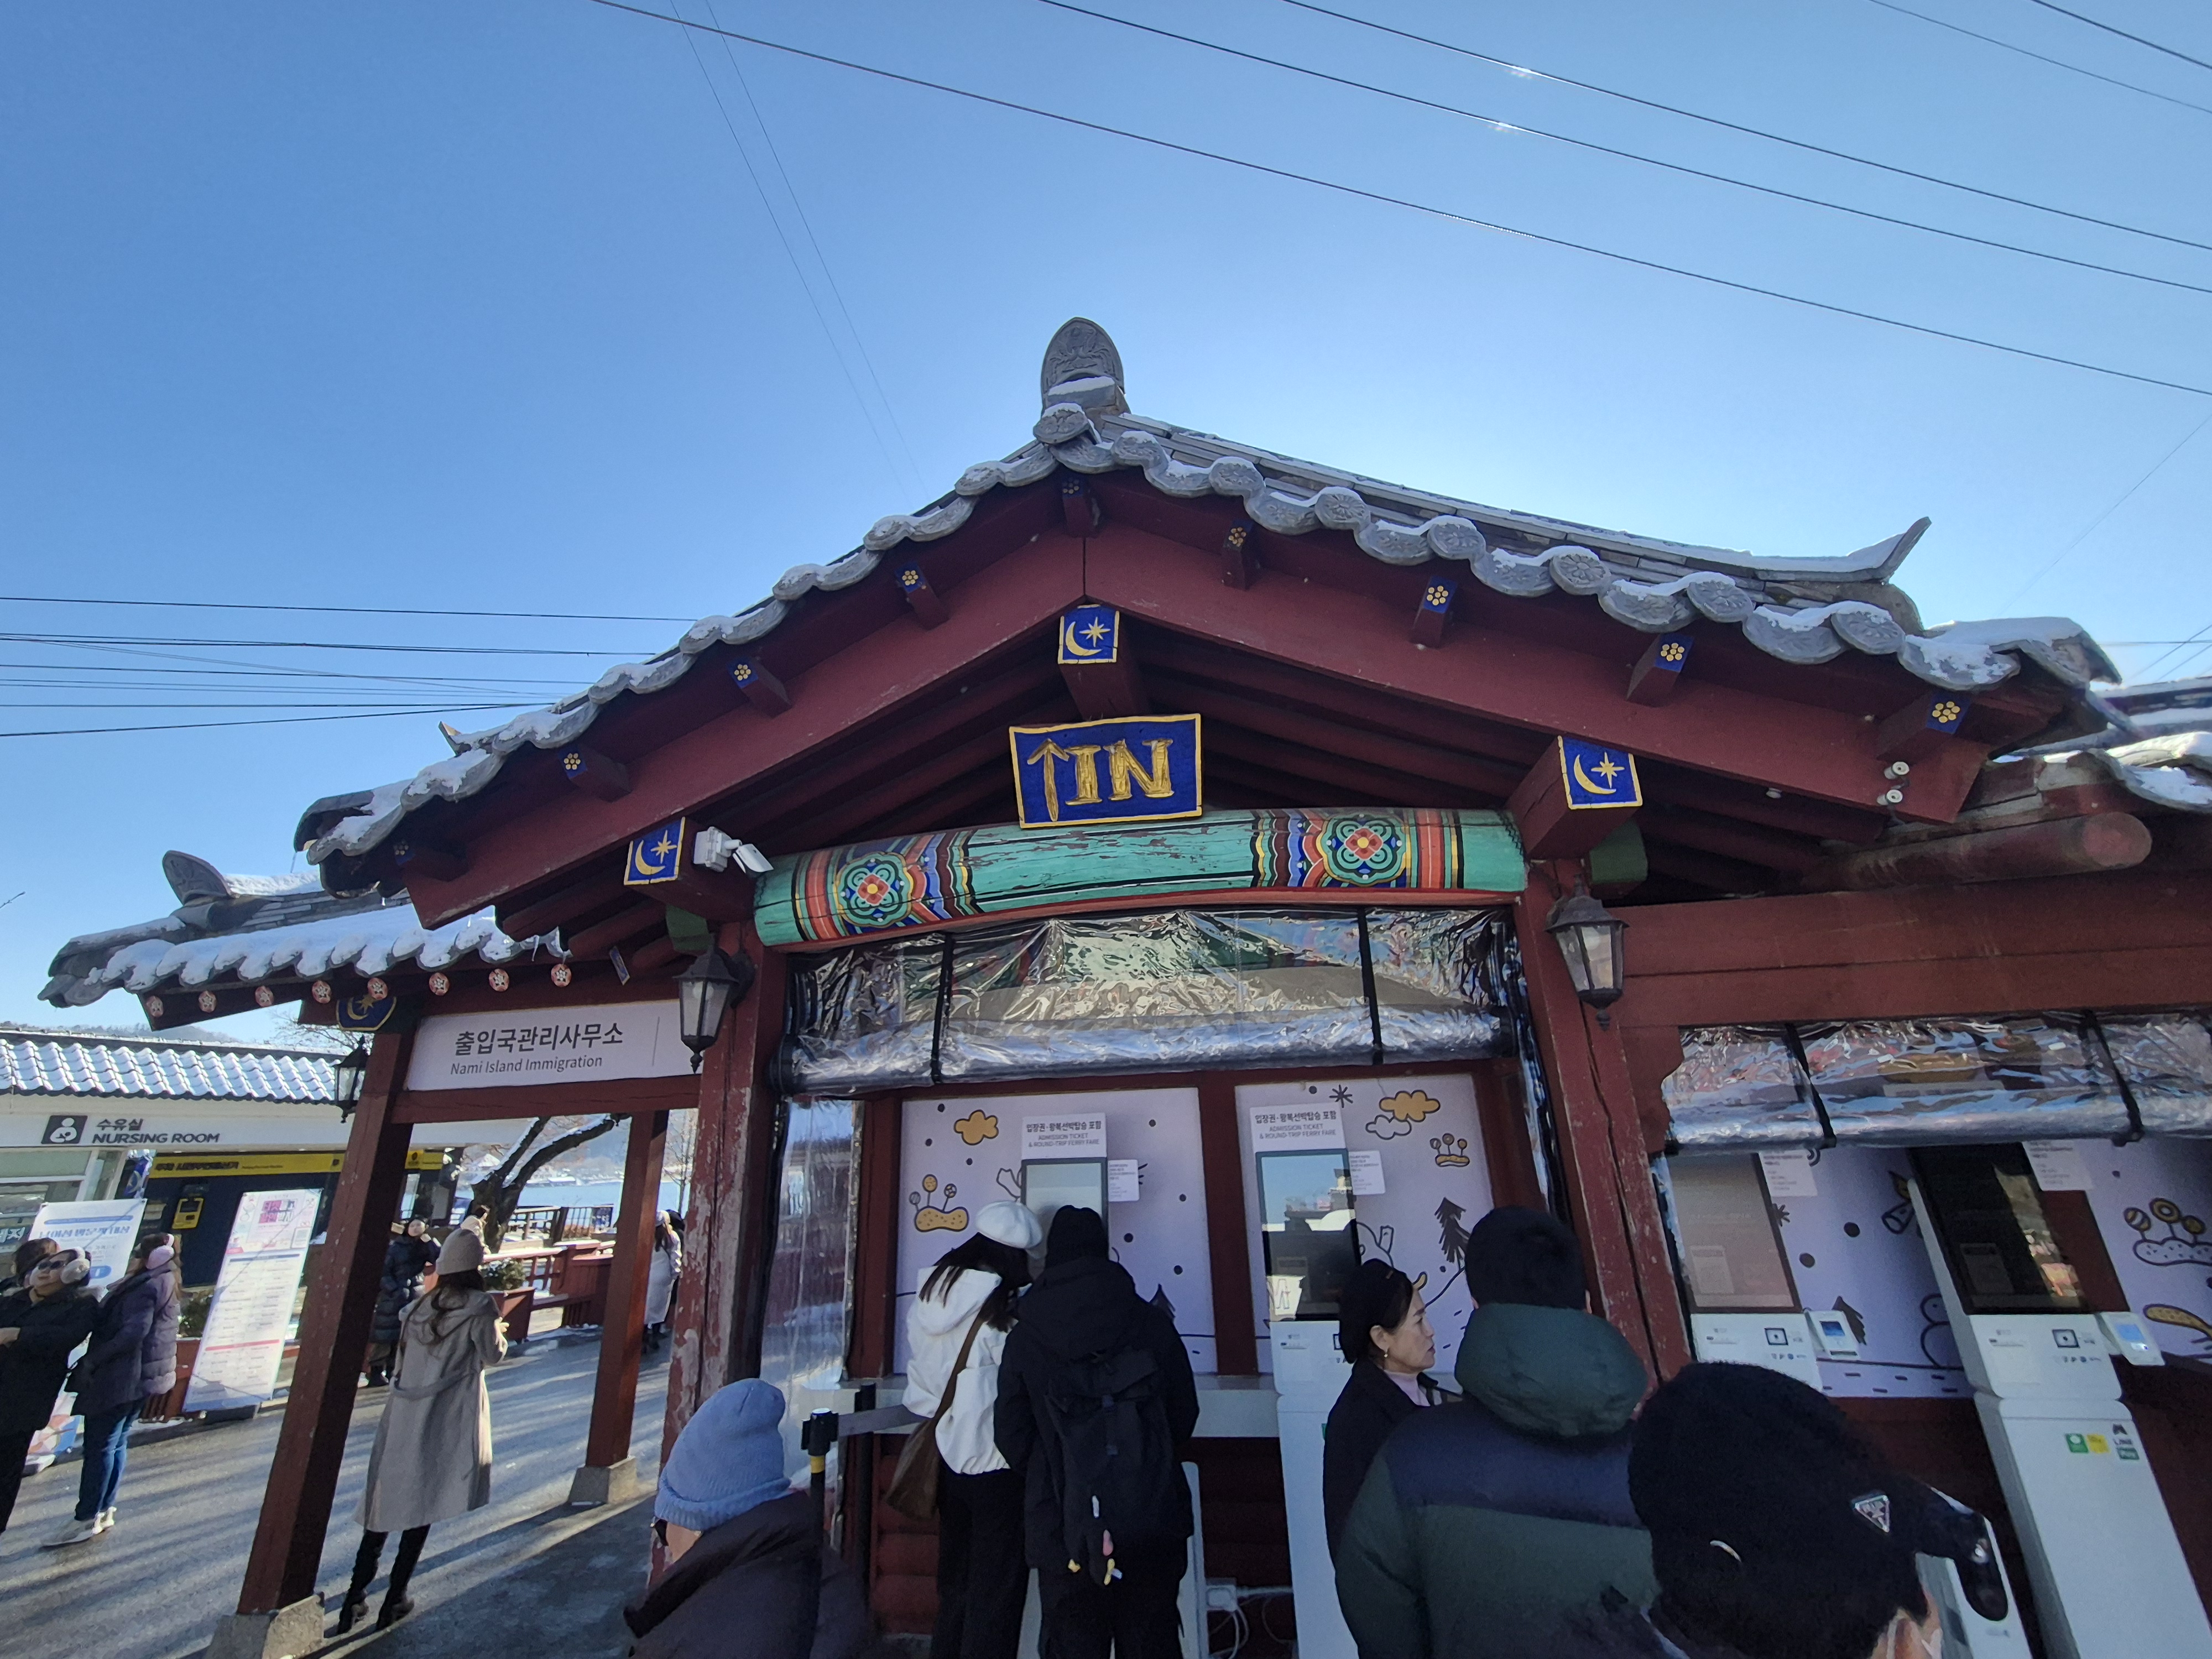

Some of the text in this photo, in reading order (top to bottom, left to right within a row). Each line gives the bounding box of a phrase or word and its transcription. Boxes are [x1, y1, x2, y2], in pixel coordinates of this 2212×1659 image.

[1065, 738, 1175, 806] IN
[455, 1022, 624, 1057] 출입국관리사무소
[450, 1055, 603, 1075] Nami Island Immigration
[96, 1119, 144, 1131] 수유실
[92, 1133, 220, 1144] NURSING ROOM
